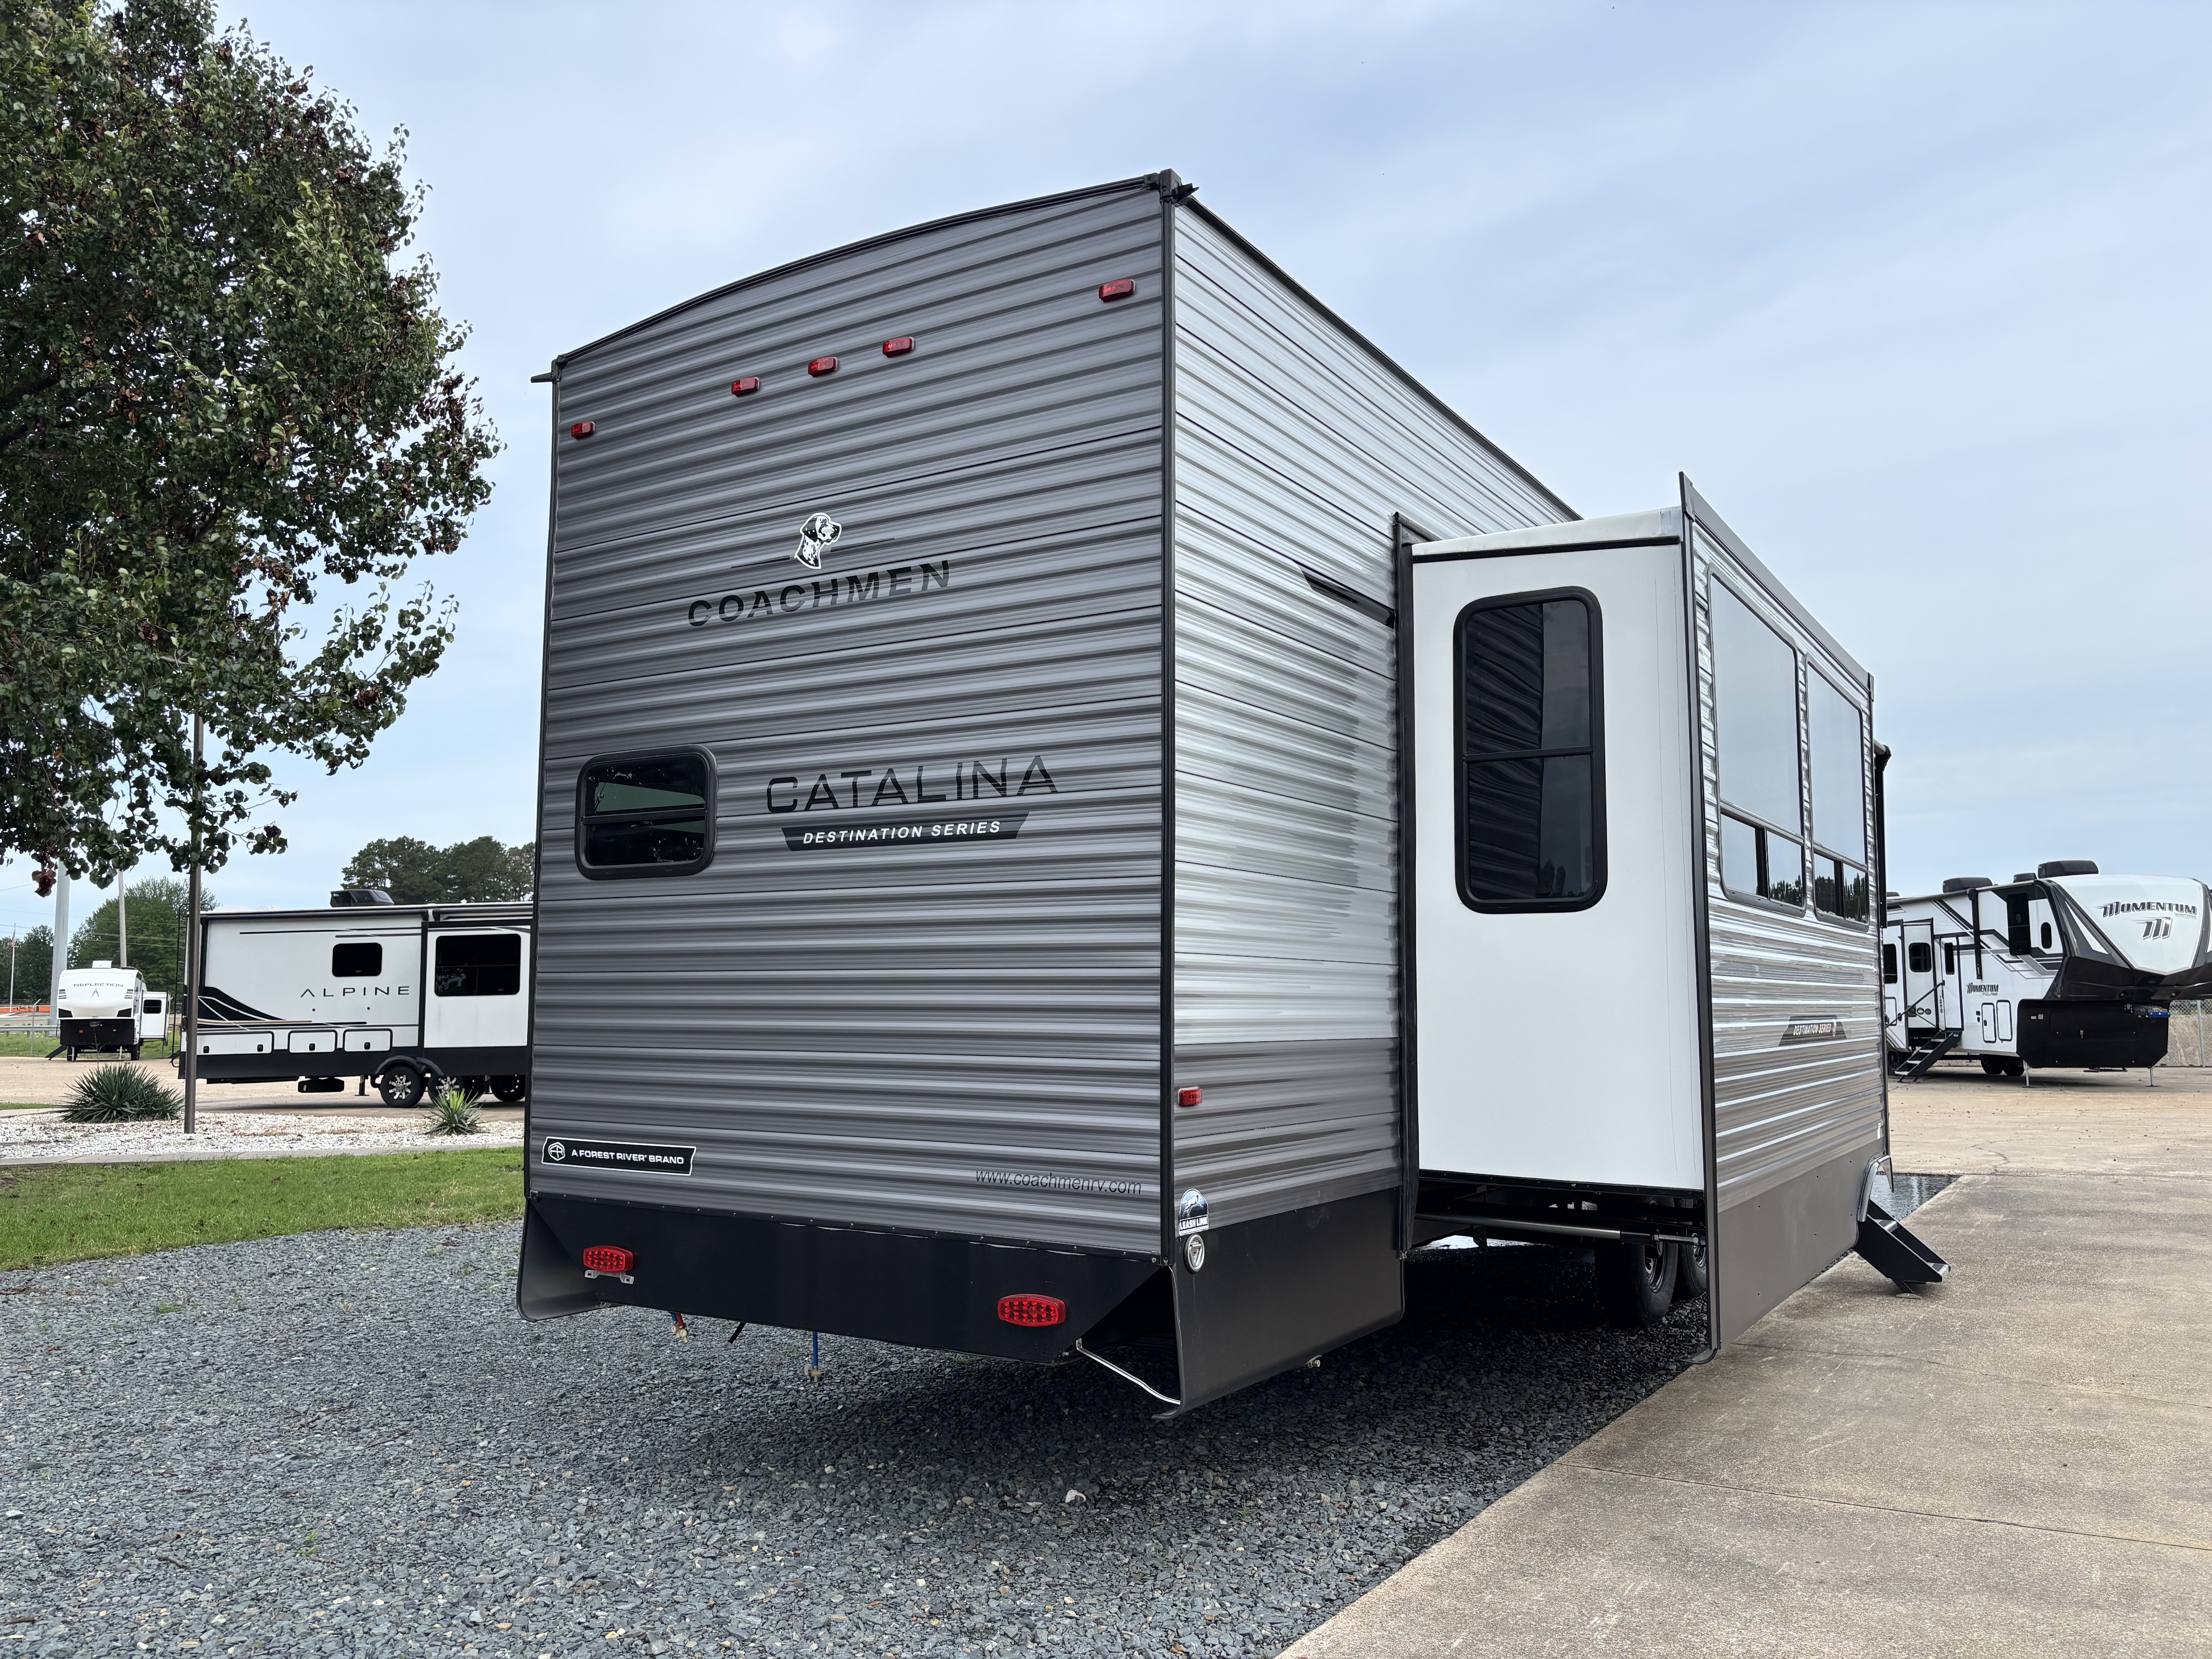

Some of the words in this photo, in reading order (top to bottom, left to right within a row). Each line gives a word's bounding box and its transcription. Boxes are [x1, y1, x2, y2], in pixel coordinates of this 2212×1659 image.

[688, 560, 950, 627] COACHMEN
[766, 755, 1058, 813] CATALINA
[803, 826, 923, 844] DESTINATION
[931, 821, 1001, 836] SERIES
[300, 986, 410, 998] ALPINE
[1793, 1024, 1818, 1036] DESTINATION
[1818, 1023, 1832, 1034] SERIES
[579, 1150, 615, 1159] FOREST
[649, 1155, 684, 1164] BRAND
[975, 1170, 1142, 1195] www.coachmenrv.com
[1180, 1219, 1196, 1230] LEASH
[1196, 1216, 1207, 1226] LINK
